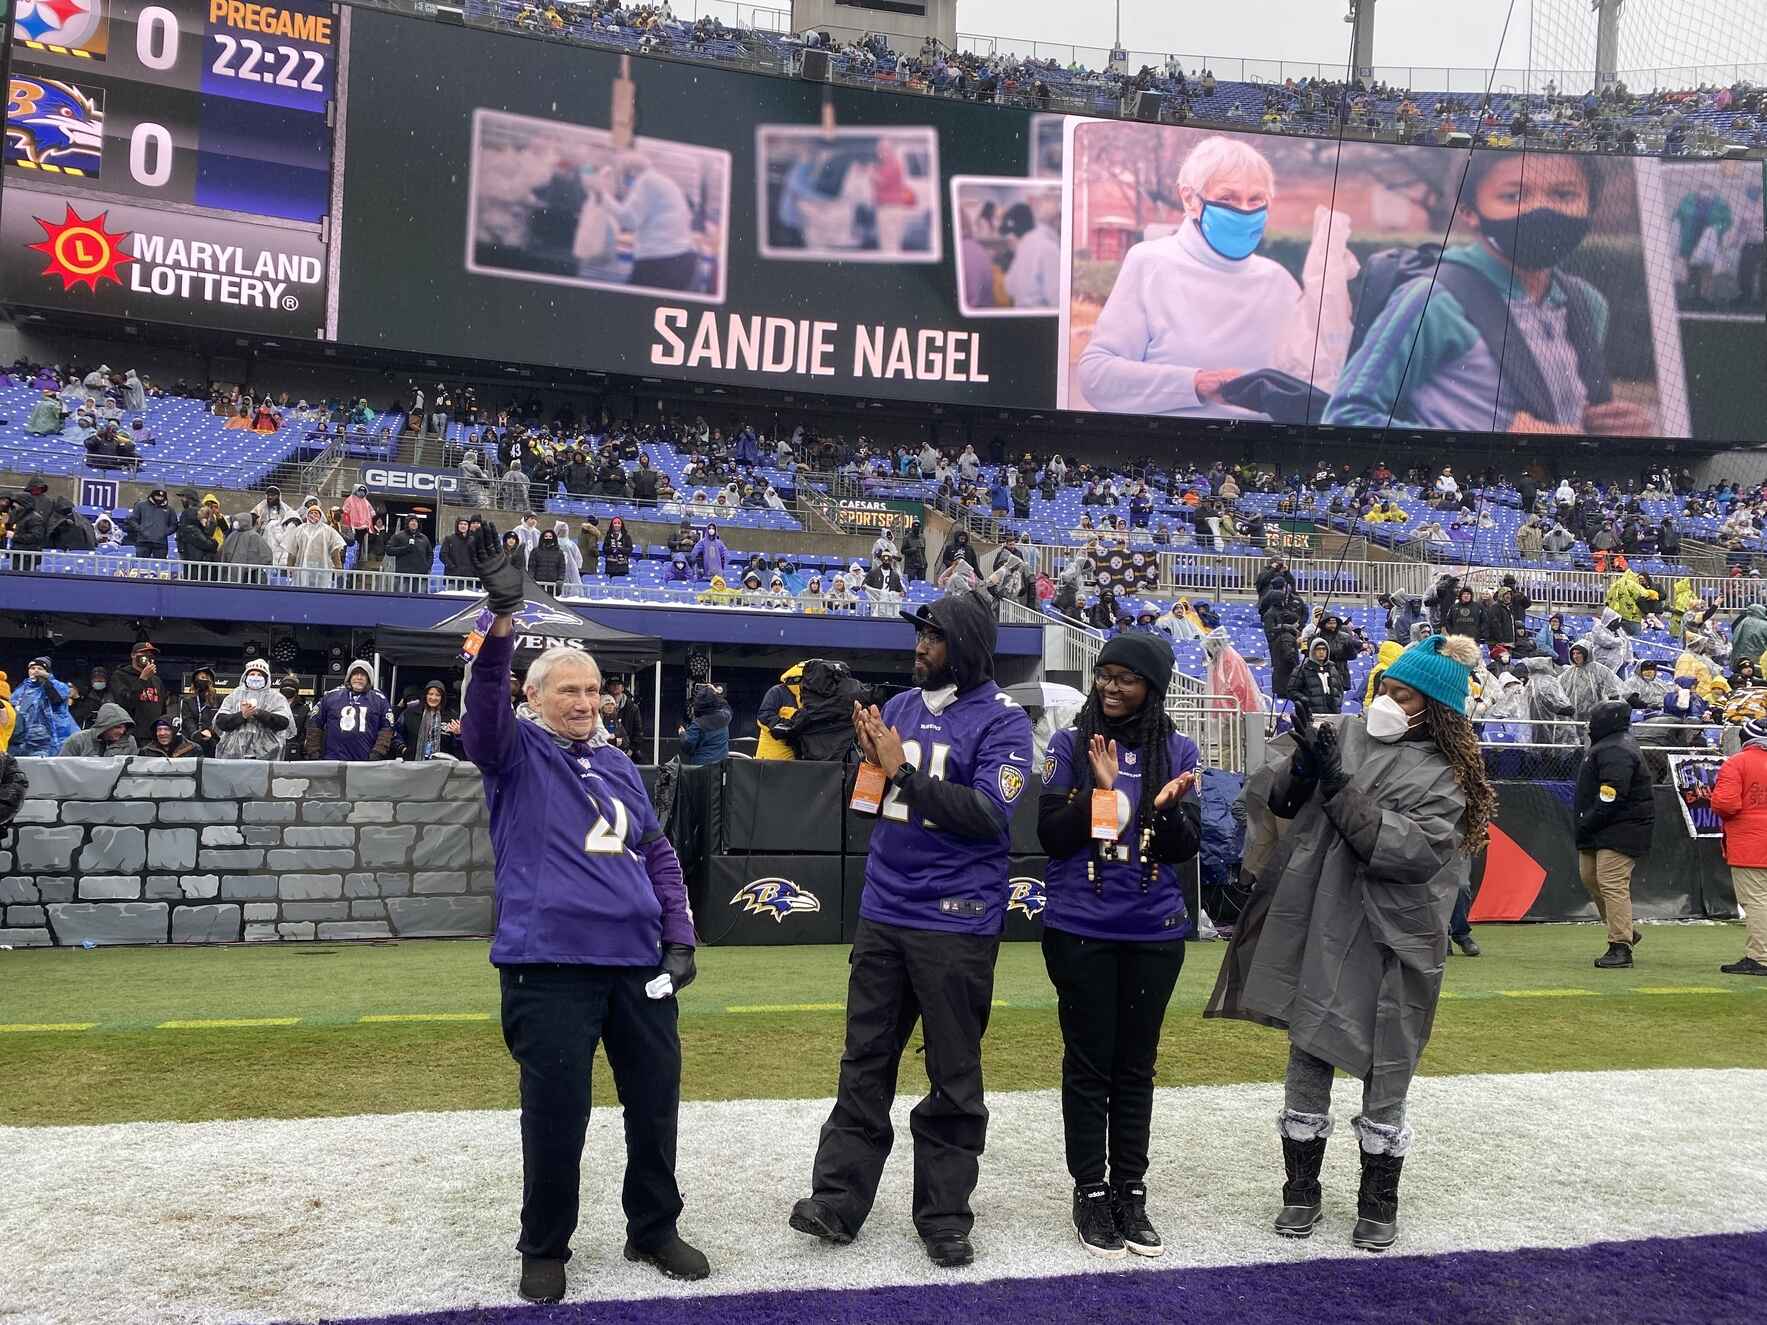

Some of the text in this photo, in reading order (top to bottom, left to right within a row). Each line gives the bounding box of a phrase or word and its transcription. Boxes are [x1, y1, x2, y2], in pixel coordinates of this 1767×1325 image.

[137, 6, 178, 70] 0
[209, 0, 331, 44] PREGAME
[212, 34, 325, 92] 22:22
[130, 122, 173, 186] 0
[76, 240, 93, 262] L
[133, 232, 321, 284] MARYLAND
[650, 306, 990, 383] SANDIE NAGEL
[87, 485, 112, 507] 111
[365, 469, 458, 492] GEICO
[839, 499, 887, 511] CAESARS
[513, 635, 585, 650] VENS
[340, 705, 368, 732] 81
